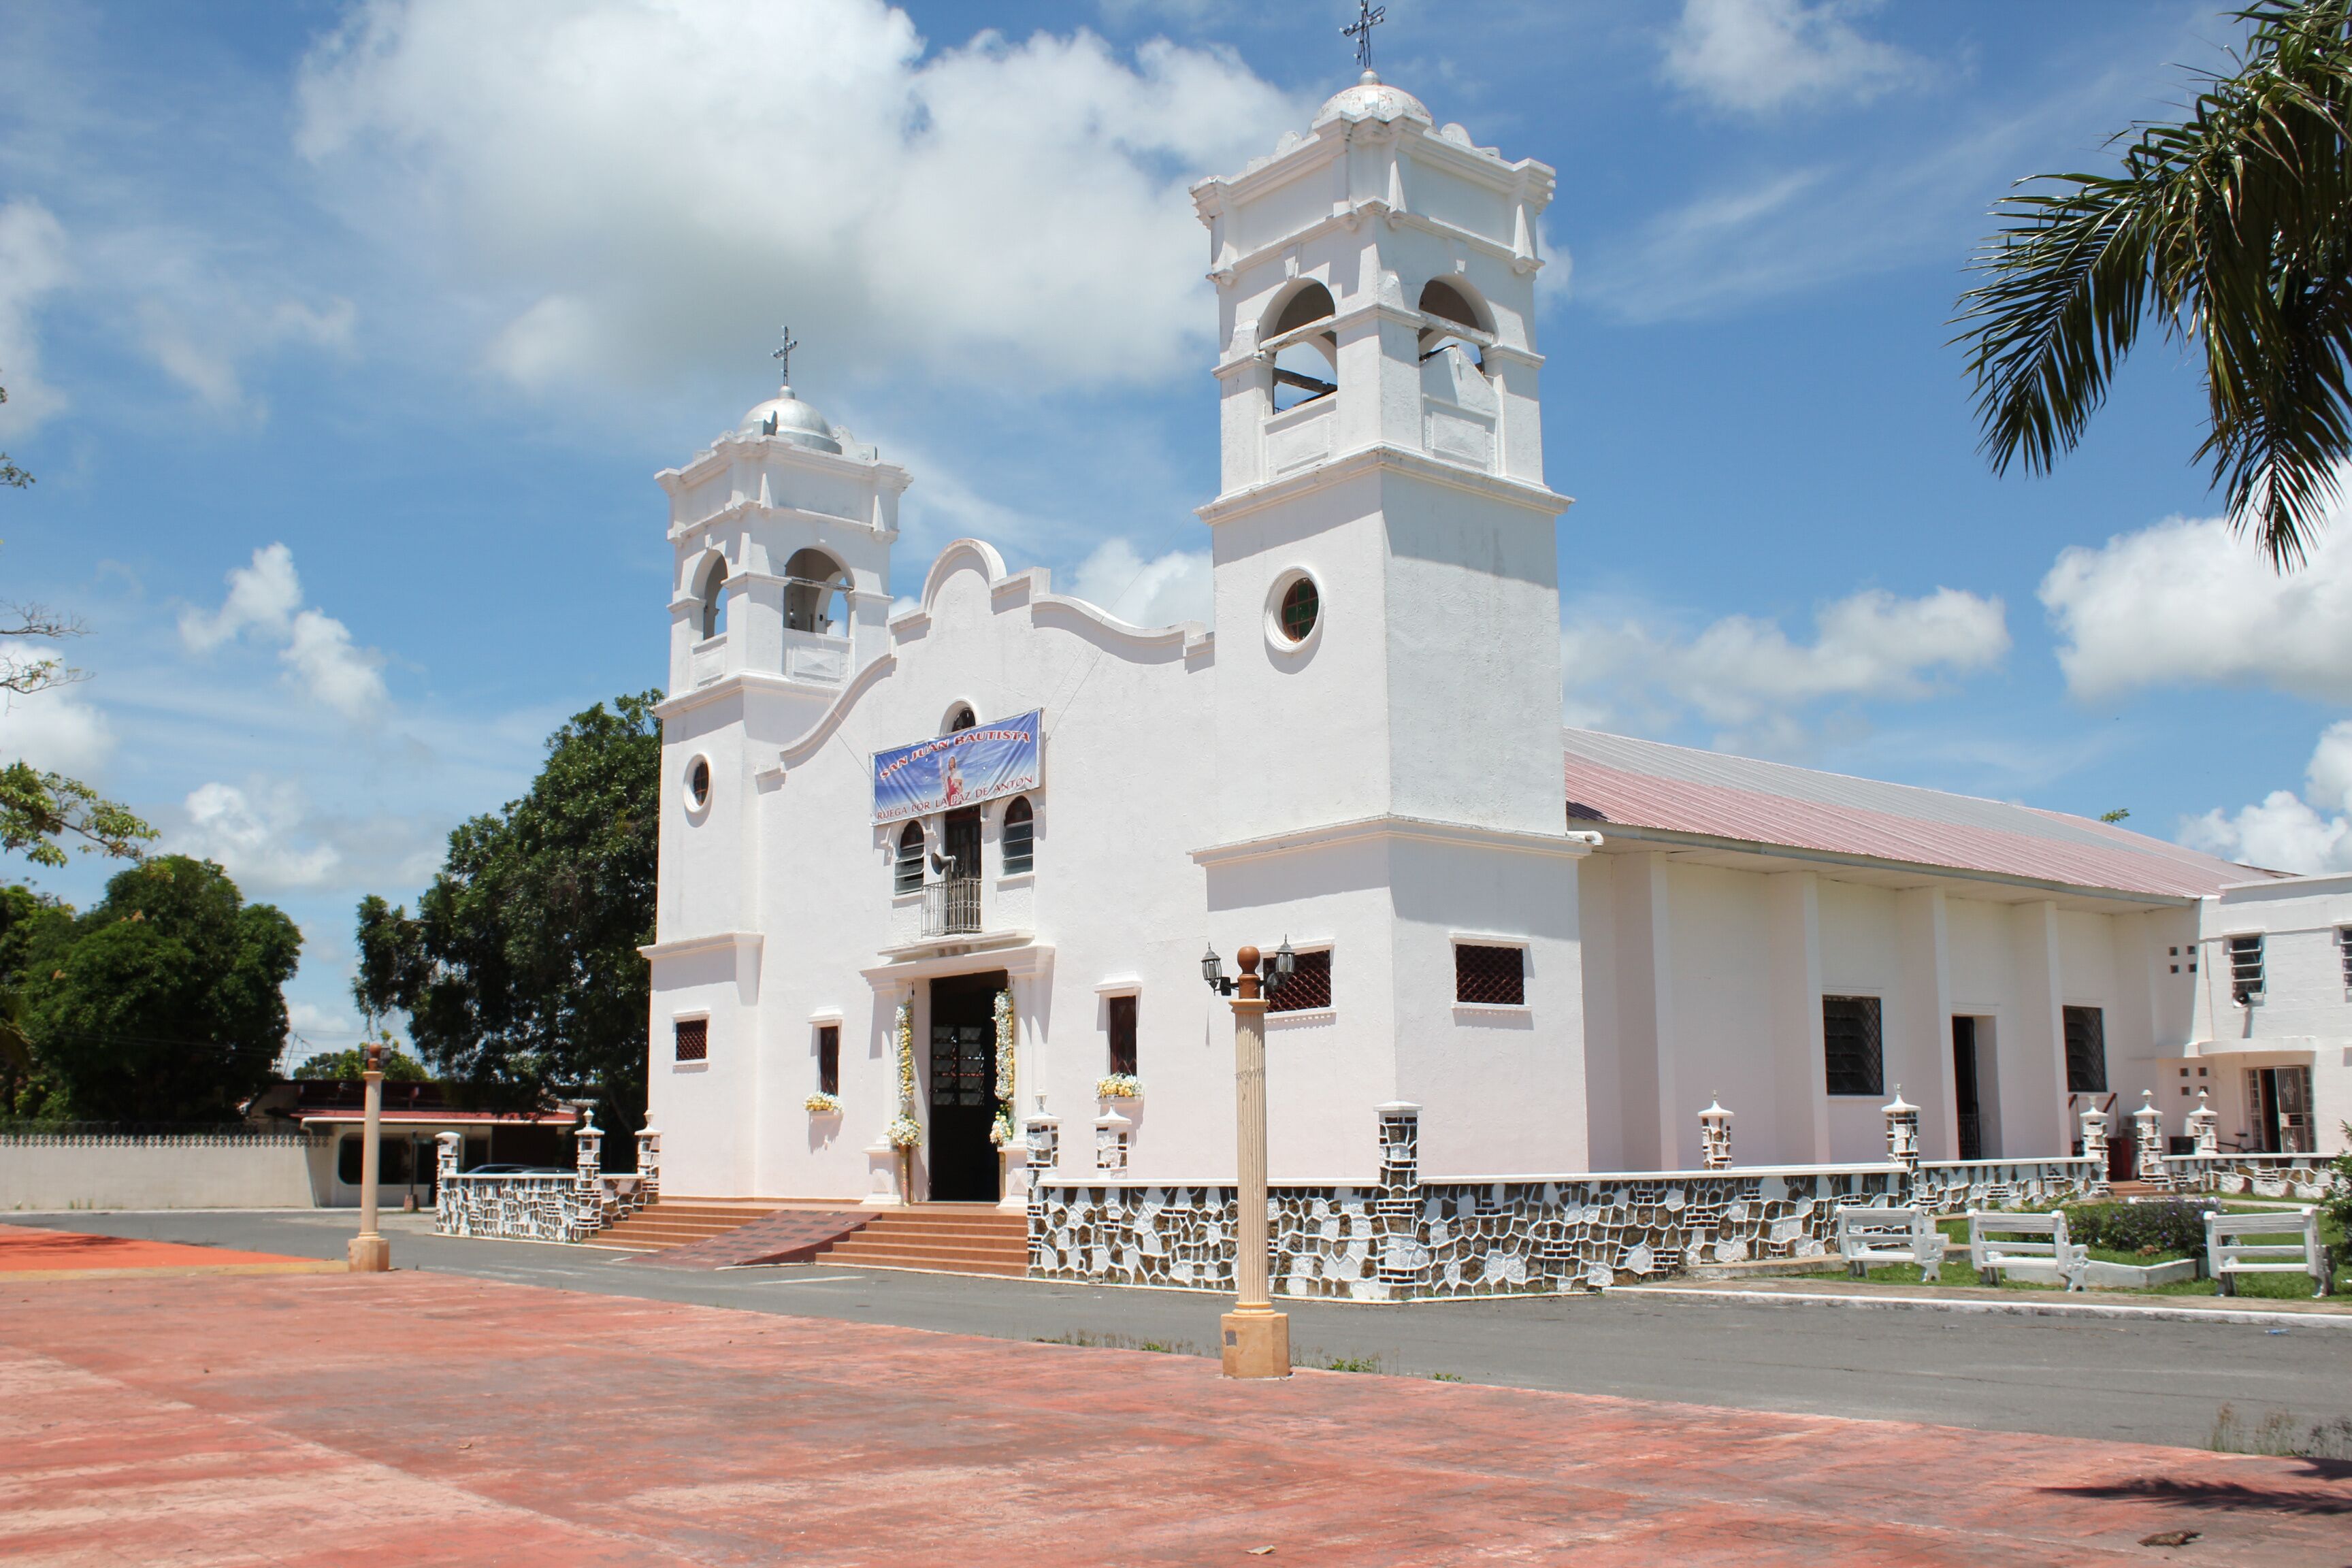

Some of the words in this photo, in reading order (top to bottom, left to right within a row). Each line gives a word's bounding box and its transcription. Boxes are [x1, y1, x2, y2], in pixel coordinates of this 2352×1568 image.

[880, 755, 908, 779] SAN
[910, 739, 949, 762] JUAN
[954, 730, 1030, 746] BAUTISTA
[877, 806, 907, 820] RUEGA
[911, 801, 930, 813] POR
[935, 798, 947, 808] LA
[950, 791, 970, 805] PAZ
[975, 787, 988, 798] DE
